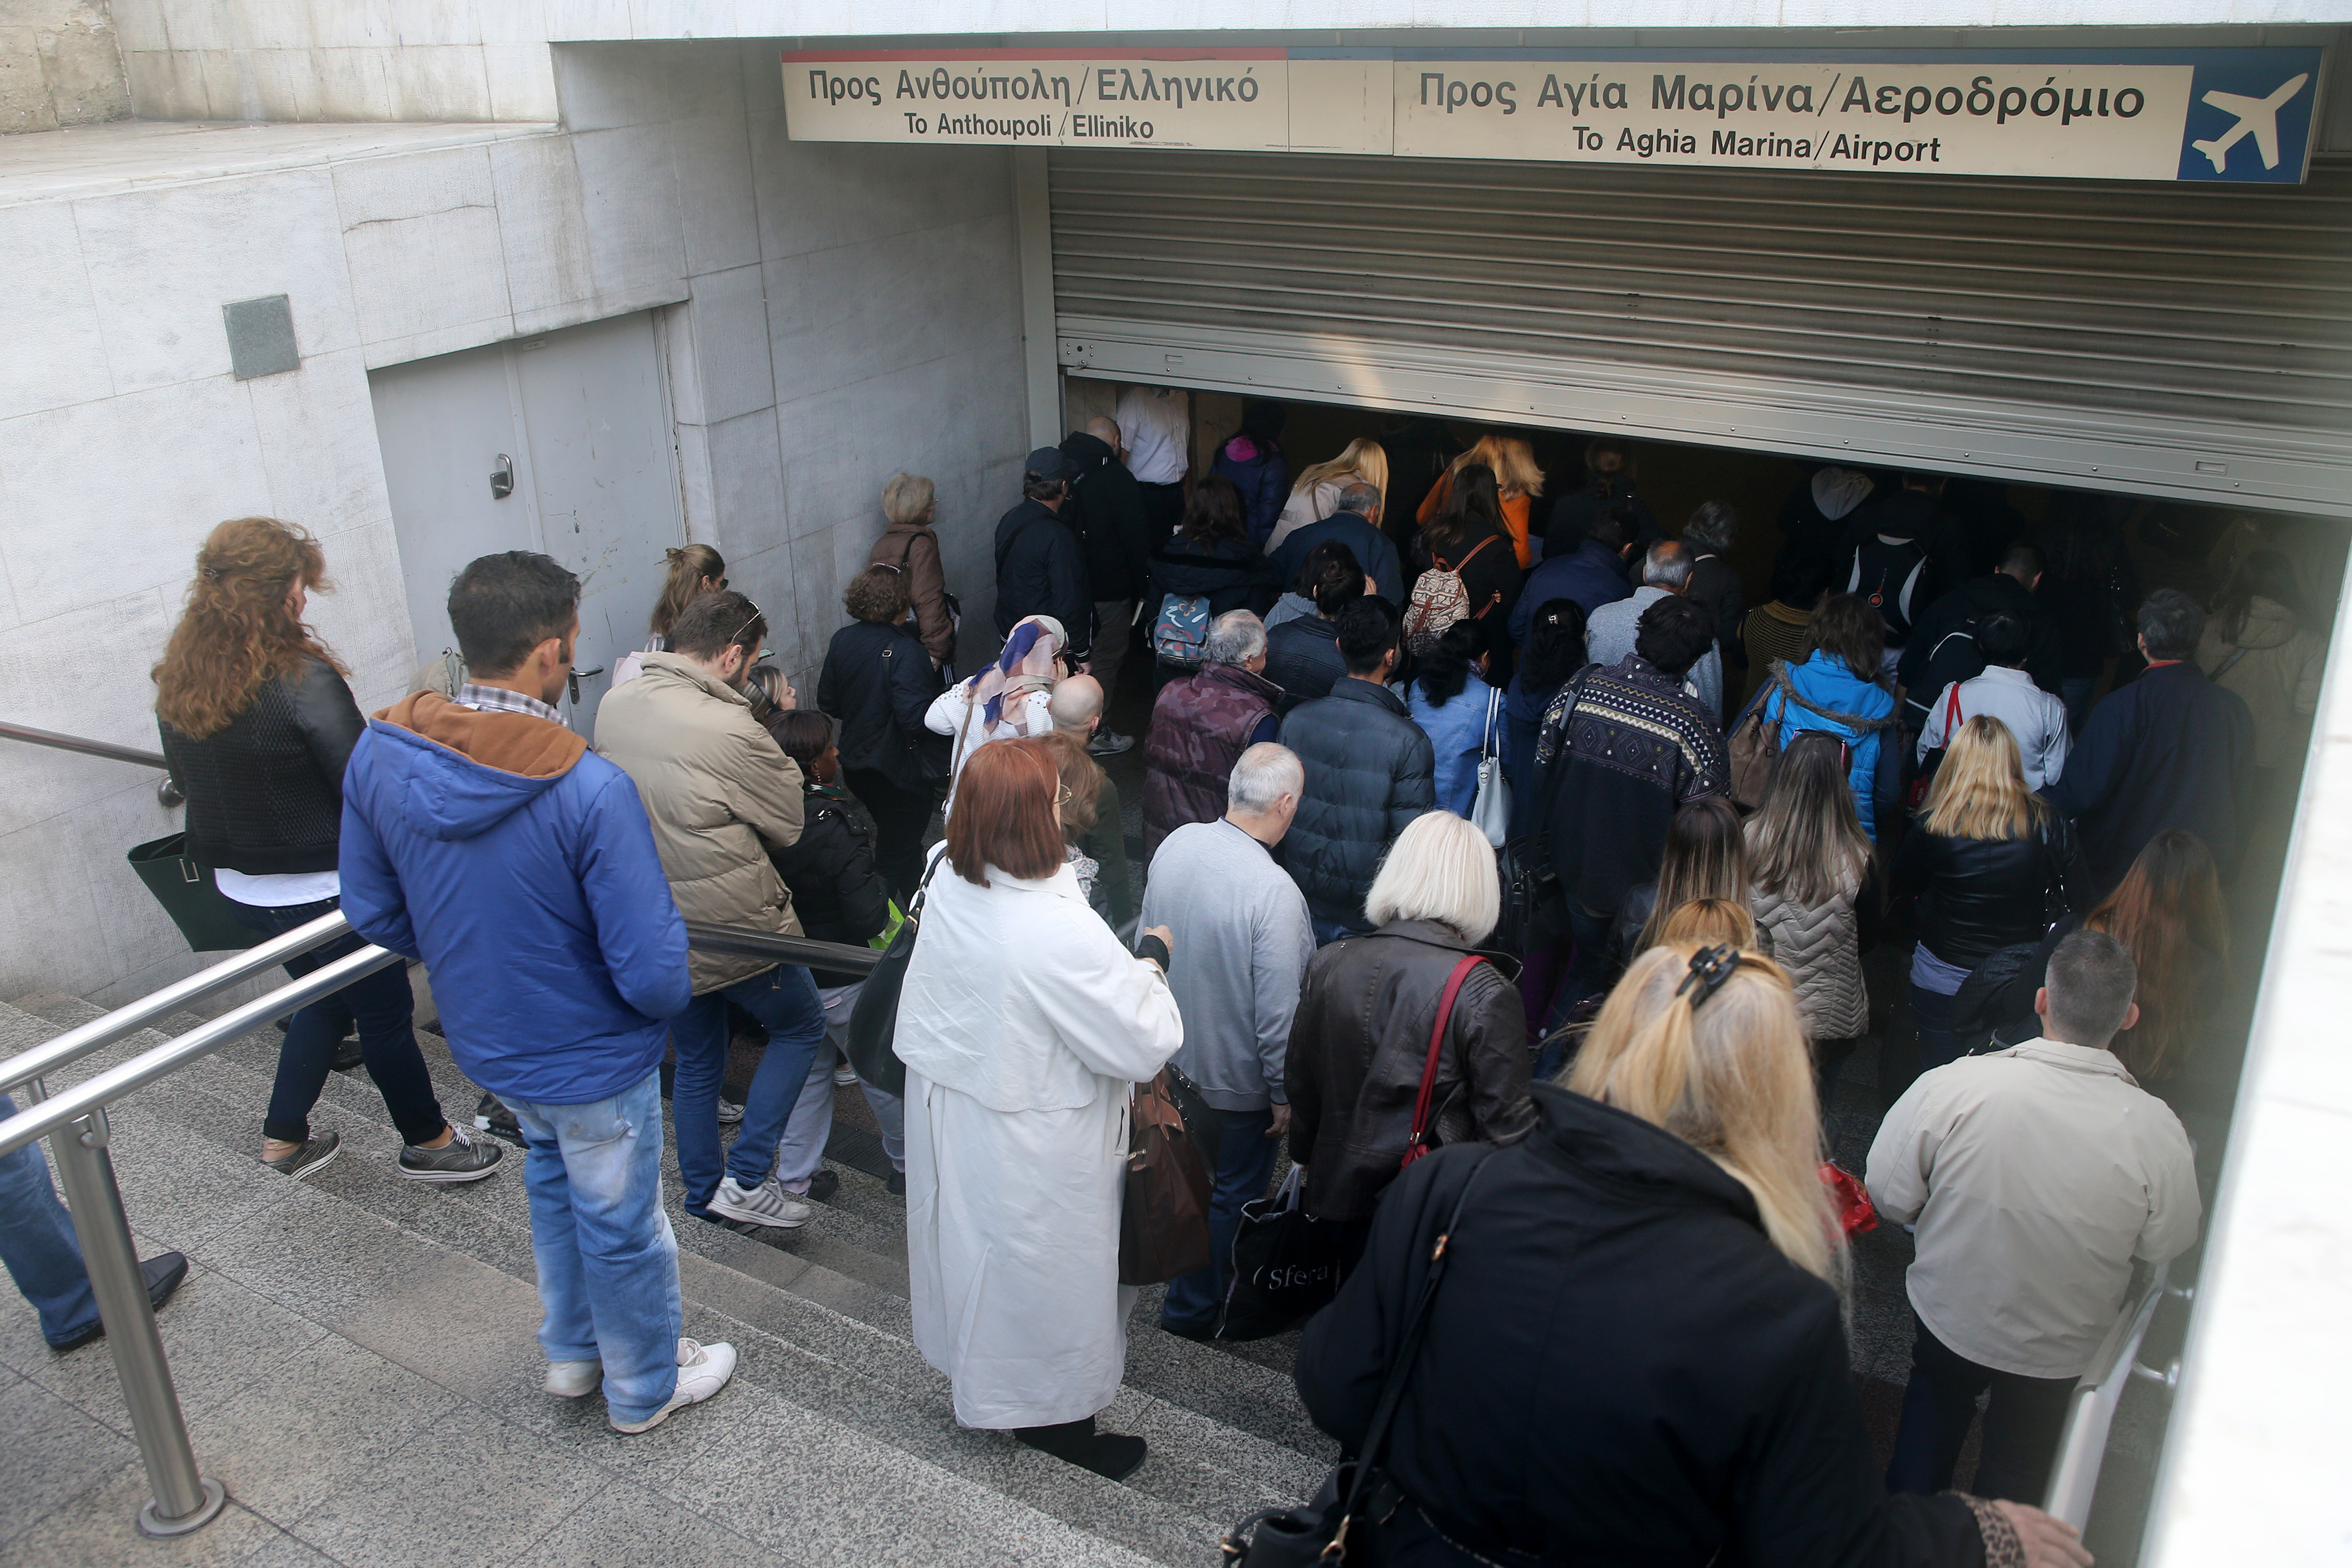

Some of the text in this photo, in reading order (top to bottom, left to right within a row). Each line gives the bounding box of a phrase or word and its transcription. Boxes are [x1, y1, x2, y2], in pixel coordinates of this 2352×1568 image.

[809, 70, 882, 106] Προς
[1420, 73, 1517, 115] Προς
[1536, 73, 1628, 117] Αγία
[903, 113, 927, 134] To
[1572, 127, 1603, 151] To
[1616, 127, 1696, 158] Aghia
